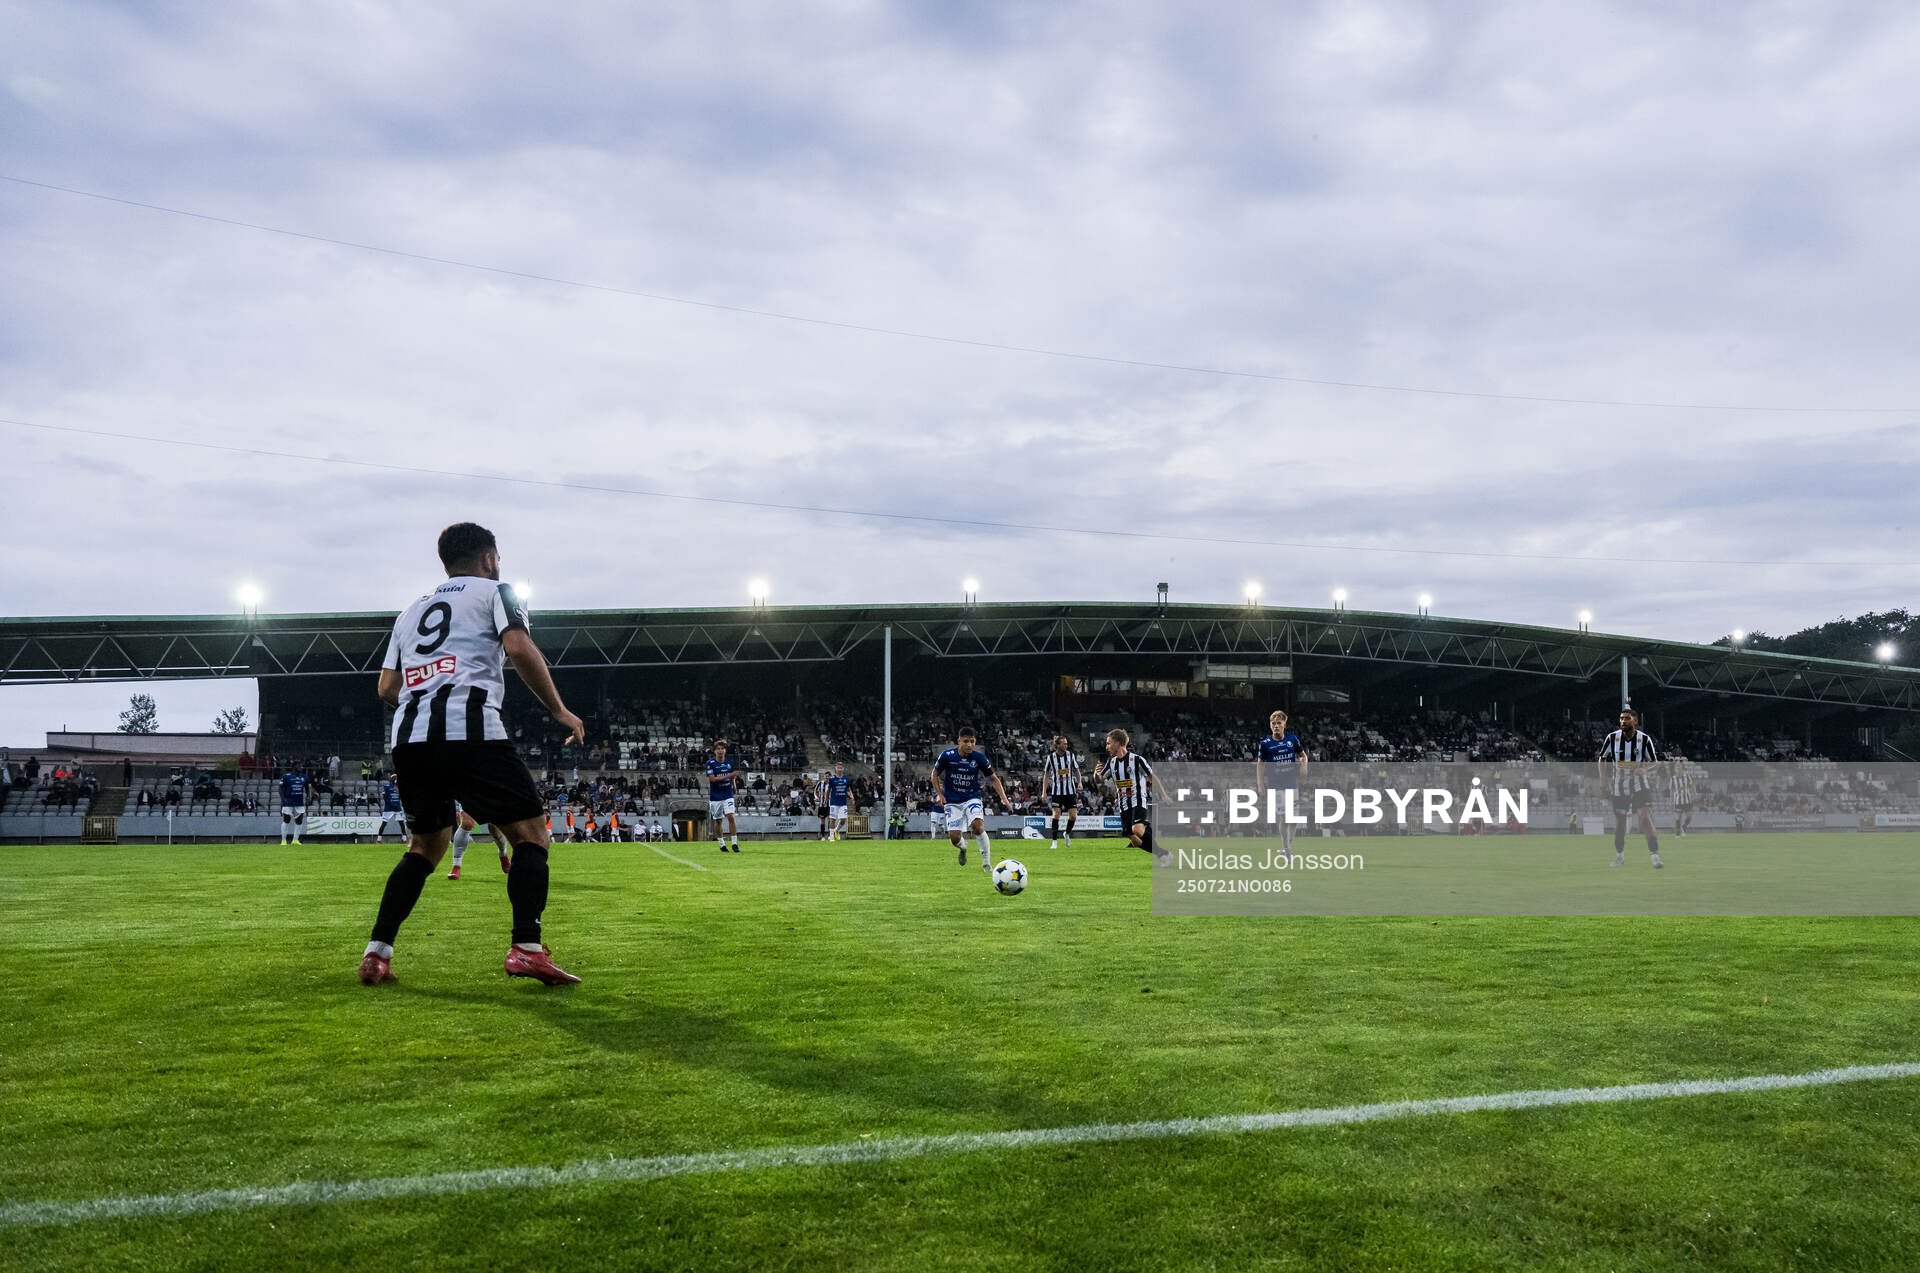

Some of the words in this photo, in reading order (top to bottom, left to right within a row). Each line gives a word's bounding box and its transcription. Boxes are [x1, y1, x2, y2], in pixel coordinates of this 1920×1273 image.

[415, 601, 452, 655] 9
[407, 658, 455, 685] PULS
[331, 819, 373, 830] alfdex
